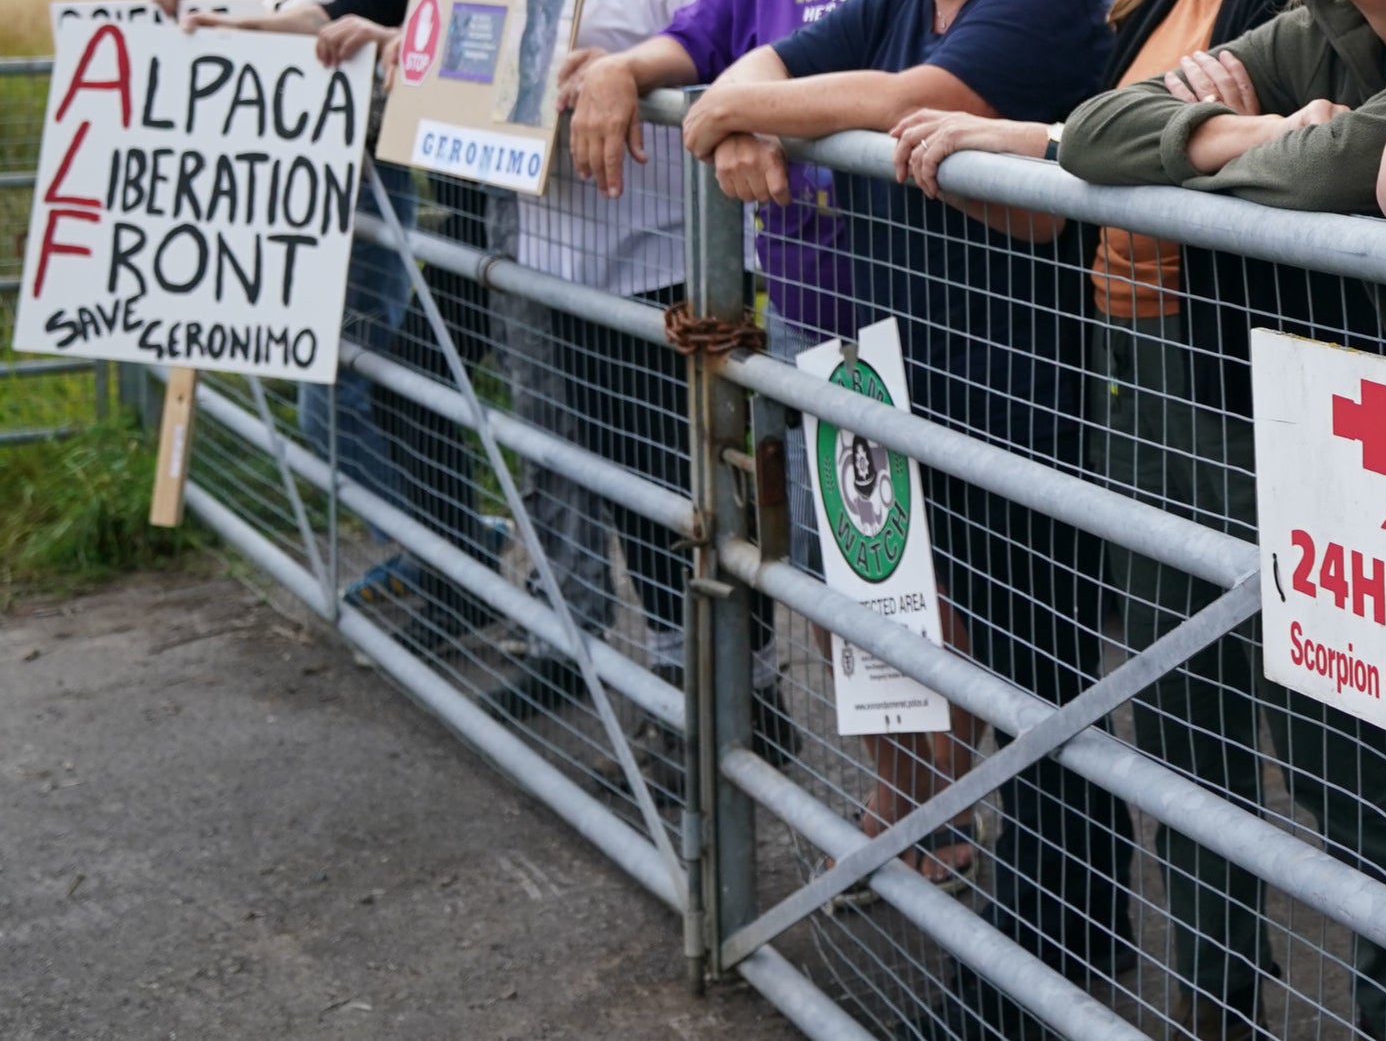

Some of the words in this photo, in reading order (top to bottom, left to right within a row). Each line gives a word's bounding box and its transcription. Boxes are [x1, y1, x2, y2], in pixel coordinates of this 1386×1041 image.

[56, 25, 356, 146] ALPACA
[405, 52, 431, 72] STOP
[45, 122, 355, 236] LIBERATION
[422, 132, 542, 178] GERONIMO
[35, 210, 318, 307] FRONT
[46, 295, 143, 348] SAVE
[139, 319, 317, 369] GERONIMO
[837, 500, 909, 575] WATCH
[899, 593, 927, 614] AREA
[1290, 529, 1386, 626] 24H
[1290, 621, 1380, 699] Scorpion
